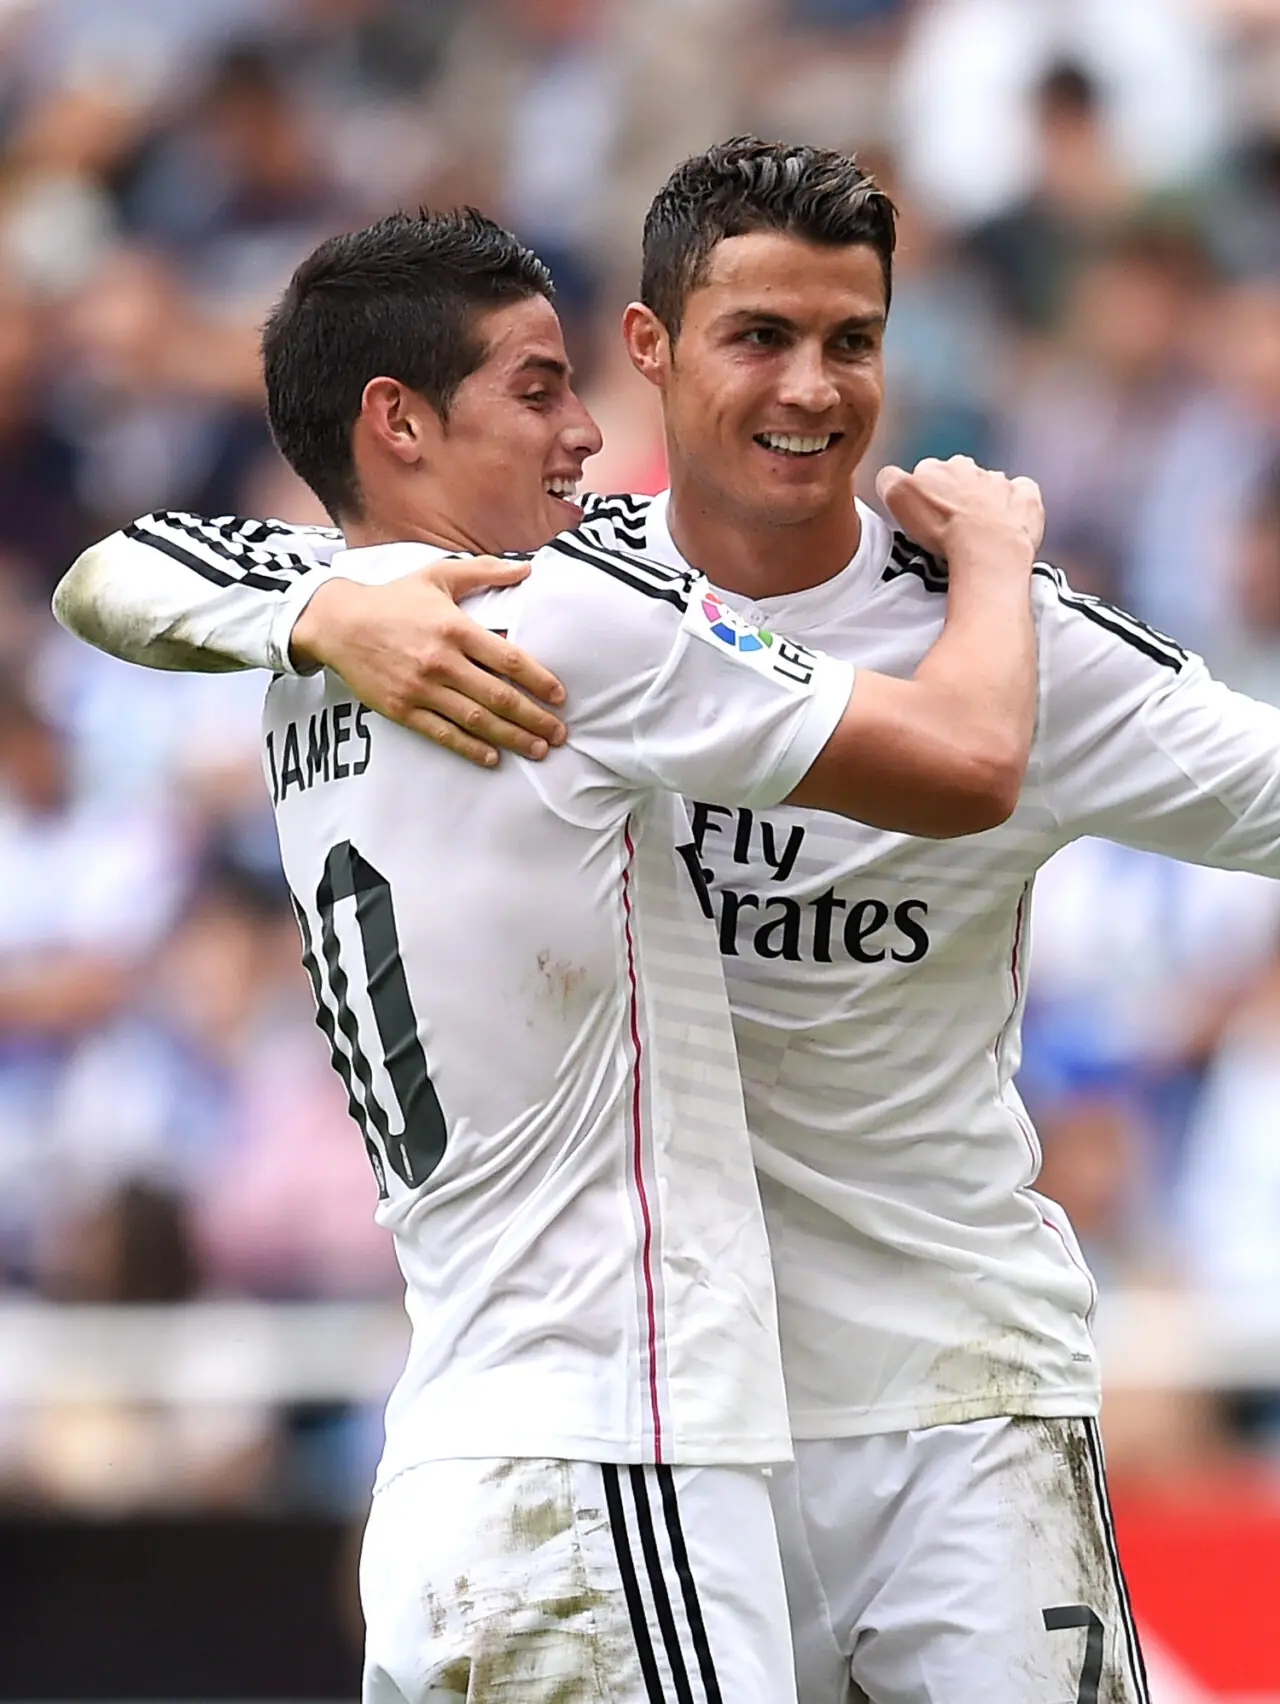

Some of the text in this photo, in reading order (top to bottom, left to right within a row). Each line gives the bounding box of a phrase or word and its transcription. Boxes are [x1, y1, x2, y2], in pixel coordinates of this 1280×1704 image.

[266, 702, 373, 808] JAMES
[691, 801, 806, 881] Fly
[700, 866, 930, 964] rates
[1042, 1604, 1105, 1704] 7
